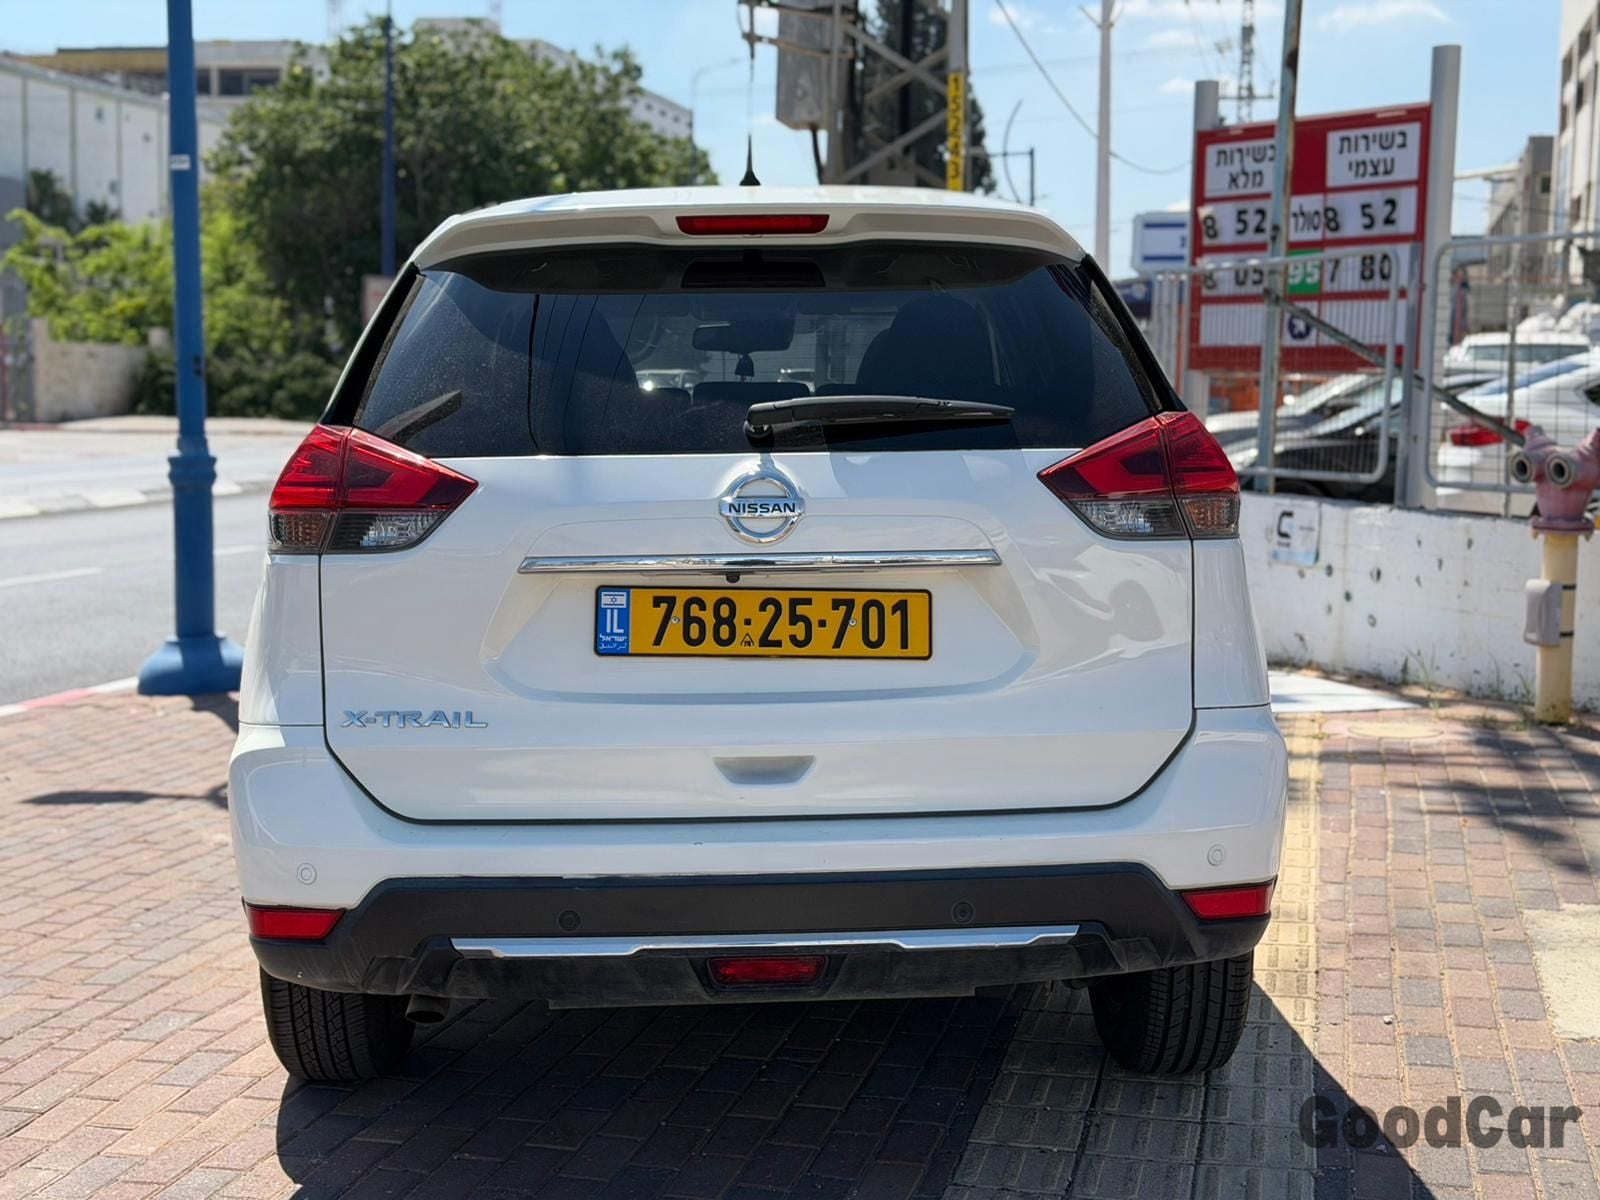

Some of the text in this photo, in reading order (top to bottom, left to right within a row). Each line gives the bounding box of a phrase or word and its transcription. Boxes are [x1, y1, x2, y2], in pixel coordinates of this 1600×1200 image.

[1339, 130, 1407, 154] בשירות
[1228, 168, 1264, 190] מלא
[1348, 157, 1395, 178] עצמי
[1203, 207, 1266, 239] 8 52
[1292, 203, 1320, 232] סולר
[1325, 206, 1339, 232] 8
[1361, 253, 1392, 281] 80
[728, 502, 796, 514] NISSAN
[606, 608, 625, 633] IL
[600, 634, 627, 642] ישראל
[341, 710, 488, 728] X-TRAIL
